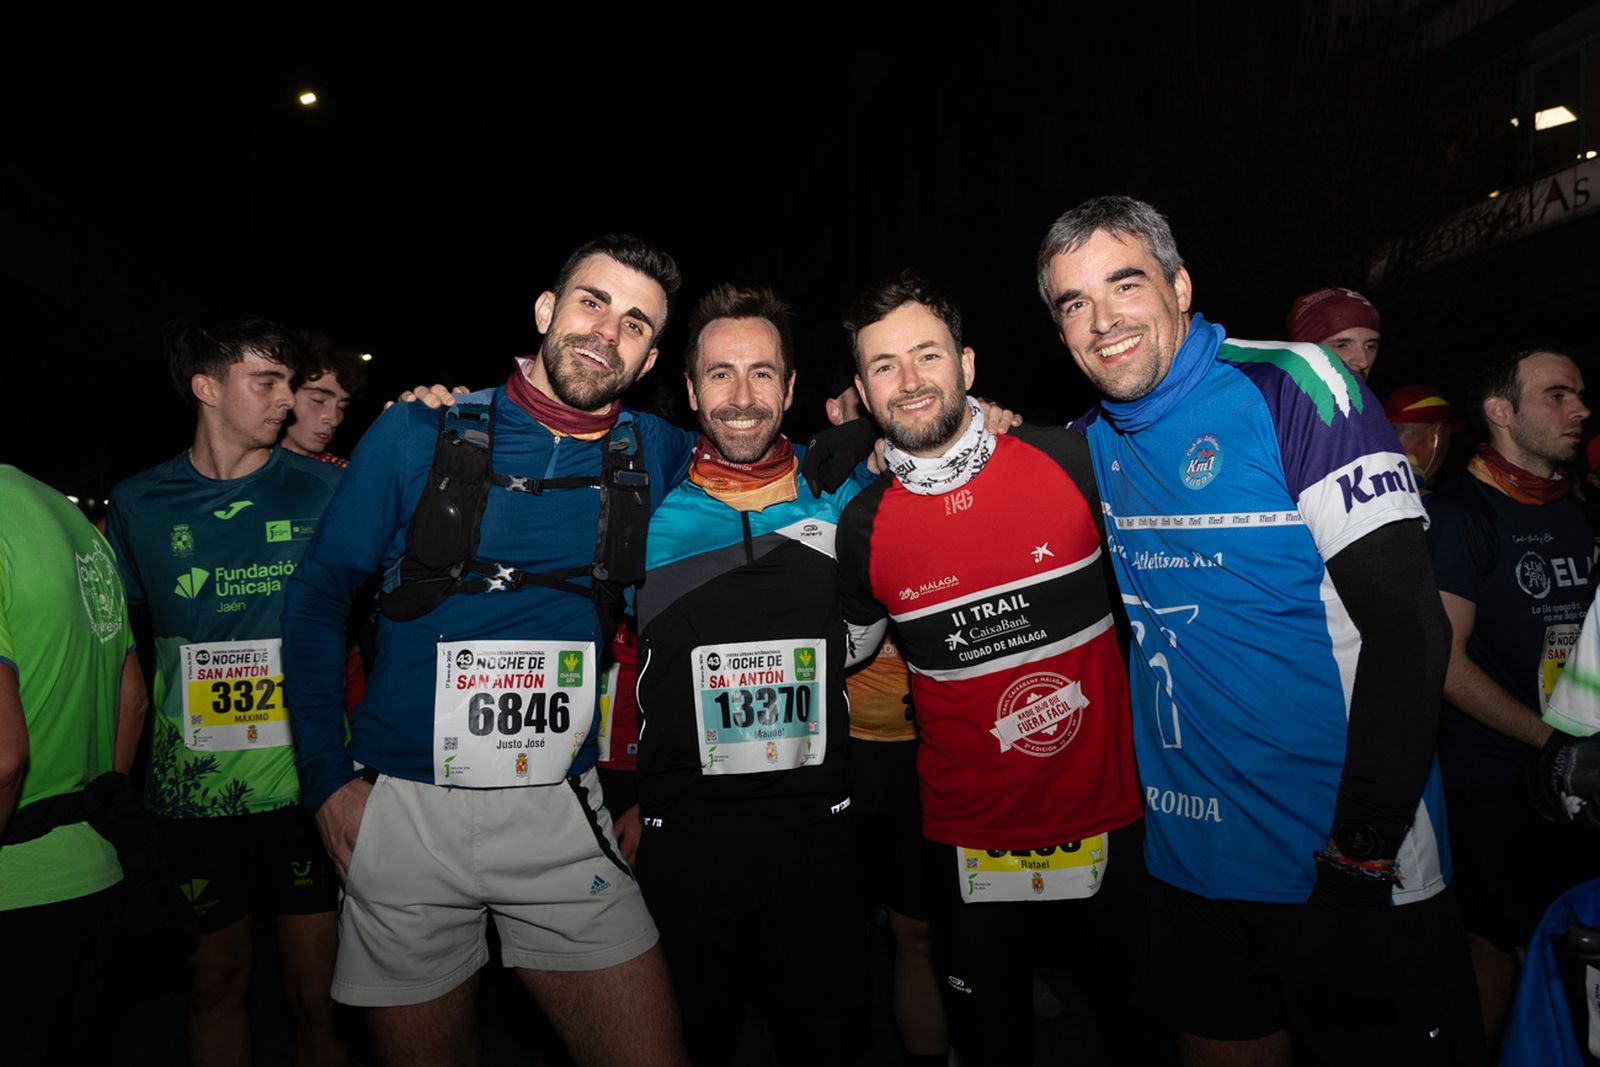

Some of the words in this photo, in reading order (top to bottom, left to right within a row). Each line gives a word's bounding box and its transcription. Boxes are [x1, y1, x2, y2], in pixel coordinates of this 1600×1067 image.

[1187, 455, 1216, 473] Km1
[1336, 461, 1415, 513] Km1
[215, 560, 298, 581] Fundació
[1550, 555, 1591, 588] EL
[215, 578, 281, 597] Unicaja
[217, 601, 247, 613] Jaén
[951, 611, 967, 627] II
[970, 594, 1030, 621] TRAIL
[969, 614, 1030, 640] CaixaBank
[958, 645, 992, 662] CIUDAD
[993, 641, 1007, 652] DE
[1008, 629, 1048, 648] MÁLAGA
[1548, 650, 1566, 660] SAN
[212, 653, 250, 665] NOCHE
[254, 652, 268, 662] DE
[457, 653, 472, 663] 43
[477, 657, 525, 670] NOCHE
[528, 657, 545, 669] DE
[707, 656, 720, 666] 43
[724, 656, 764, 670] NOCHE
[767, 655, 782, 667] DE
[197, 668, 223, 680] SAN
[226, 664, 268, 679] ANTÓN
[456, 674, 489, 689] SAN
[493, 670, 544, 689] ANTÓN
[739, 667, 784, 686] ANTÓN
[212, 678, 288, 714] 3321
[468, 692, 570, 736] 6846
[715, 685, 811, 728] 13370
[234, 713, 269, 723] MÁXIMO
[1017, 714, 1047, 734] FUERA
[496, 739, 522, 750] Justo
[525, 737, 545, 749] José
[1146, 786, 1223, 823] RONDA
[1021, 860, 1050, 869] Rafael
